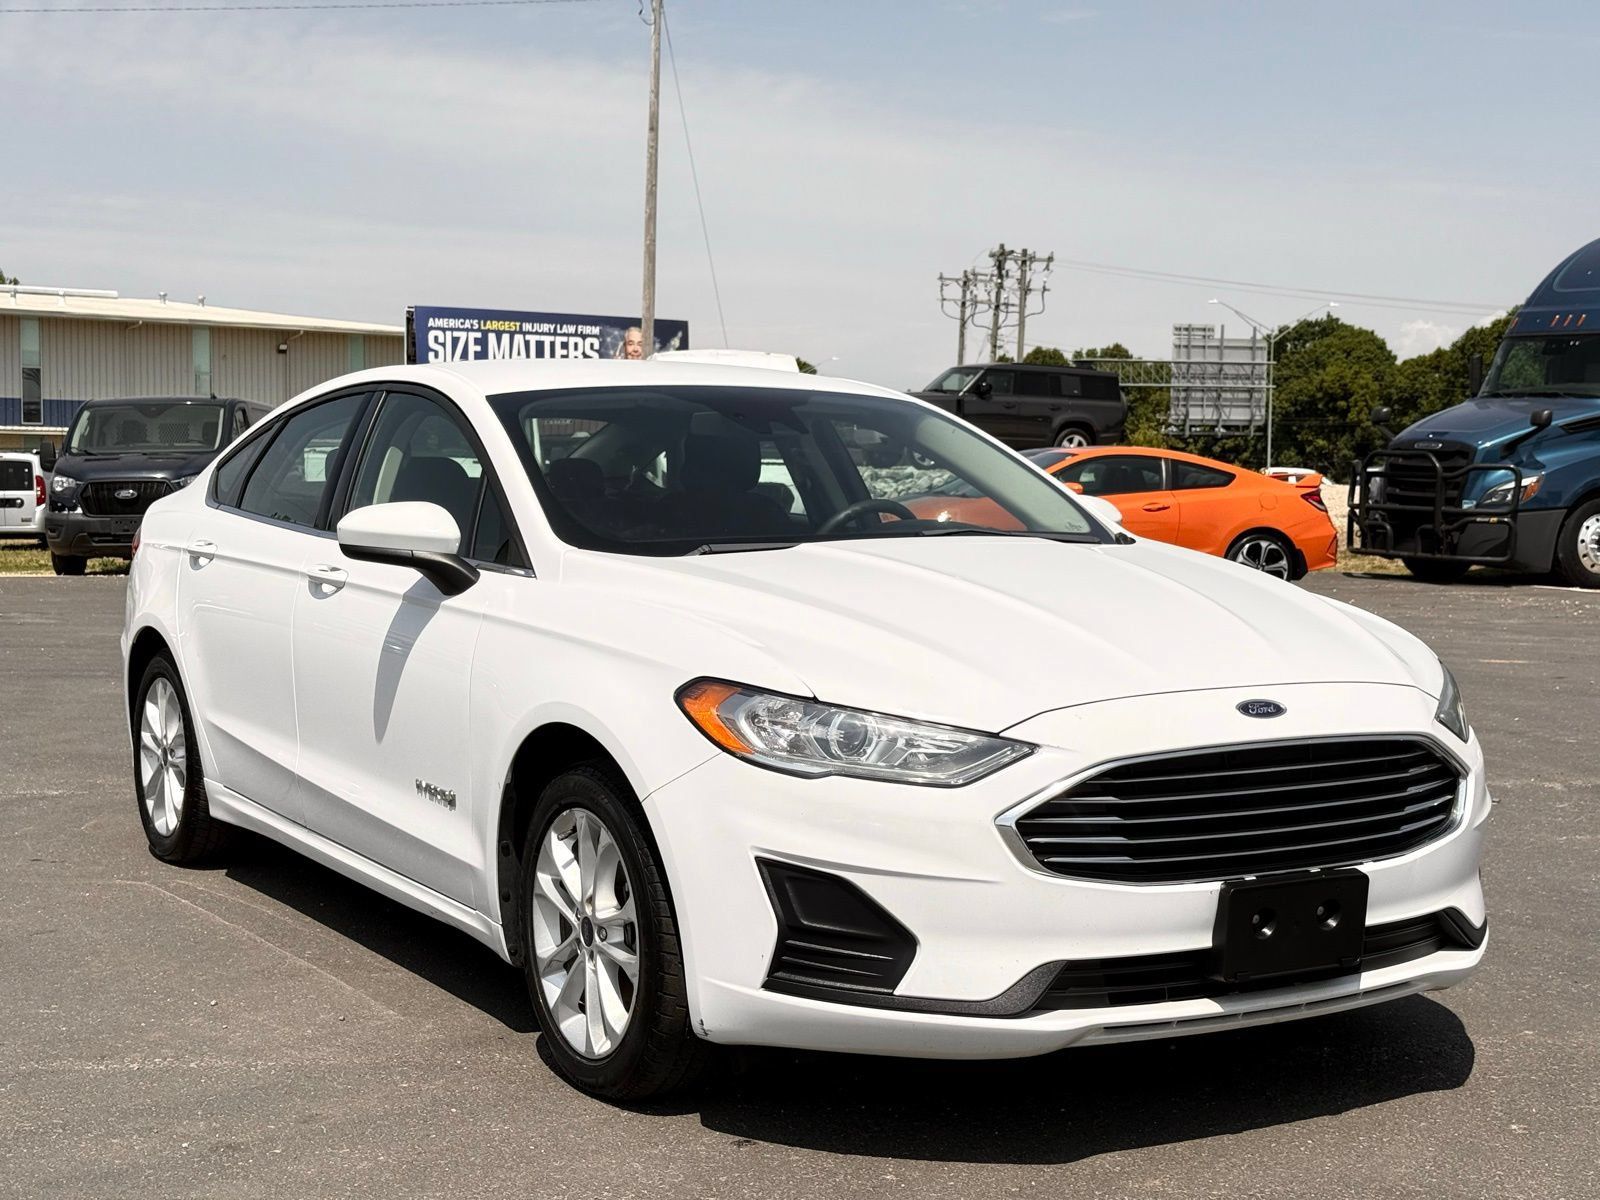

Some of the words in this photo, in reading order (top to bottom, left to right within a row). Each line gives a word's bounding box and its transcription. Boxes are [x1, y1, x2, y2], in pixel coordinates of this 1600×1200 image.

[428, 317, 479, 330] AMERICA'S
[480, 320, 521, 332] LARGEST
[522, 322, 556, 334] INJURY
[556, 323, 577, 335] LAW
[577, 325, 600, 336] FIRM
[427, 329, 482, 362] SIZE
[487, 332, 600, 361] MATTERS
[1248, 702, 1276, 714] Ford
